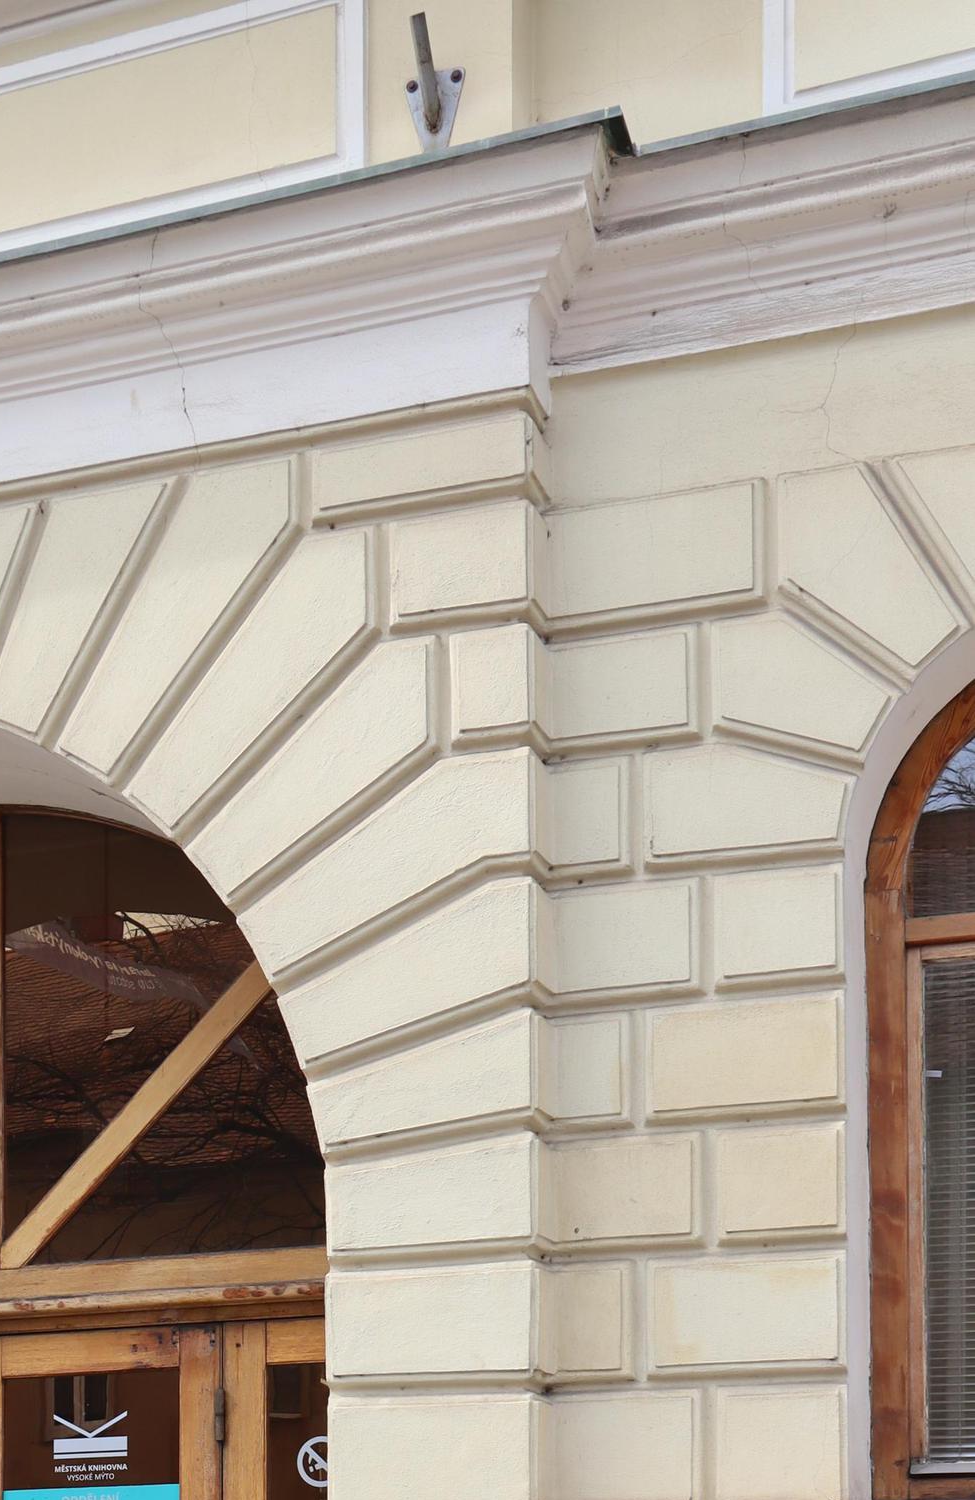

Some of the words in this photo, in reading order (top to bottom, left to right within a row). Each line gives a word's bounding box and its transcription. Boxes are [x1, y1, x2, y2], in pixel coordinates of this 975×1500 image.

[54, 1464, 86, 1473] MĚSTSKÁ
[88, 1463, 128, 1472] KNIHOVNA
[67, 1473, 93, 1481] VYSOKÉ
[94, 1472, 115, 1480] MÝTO
